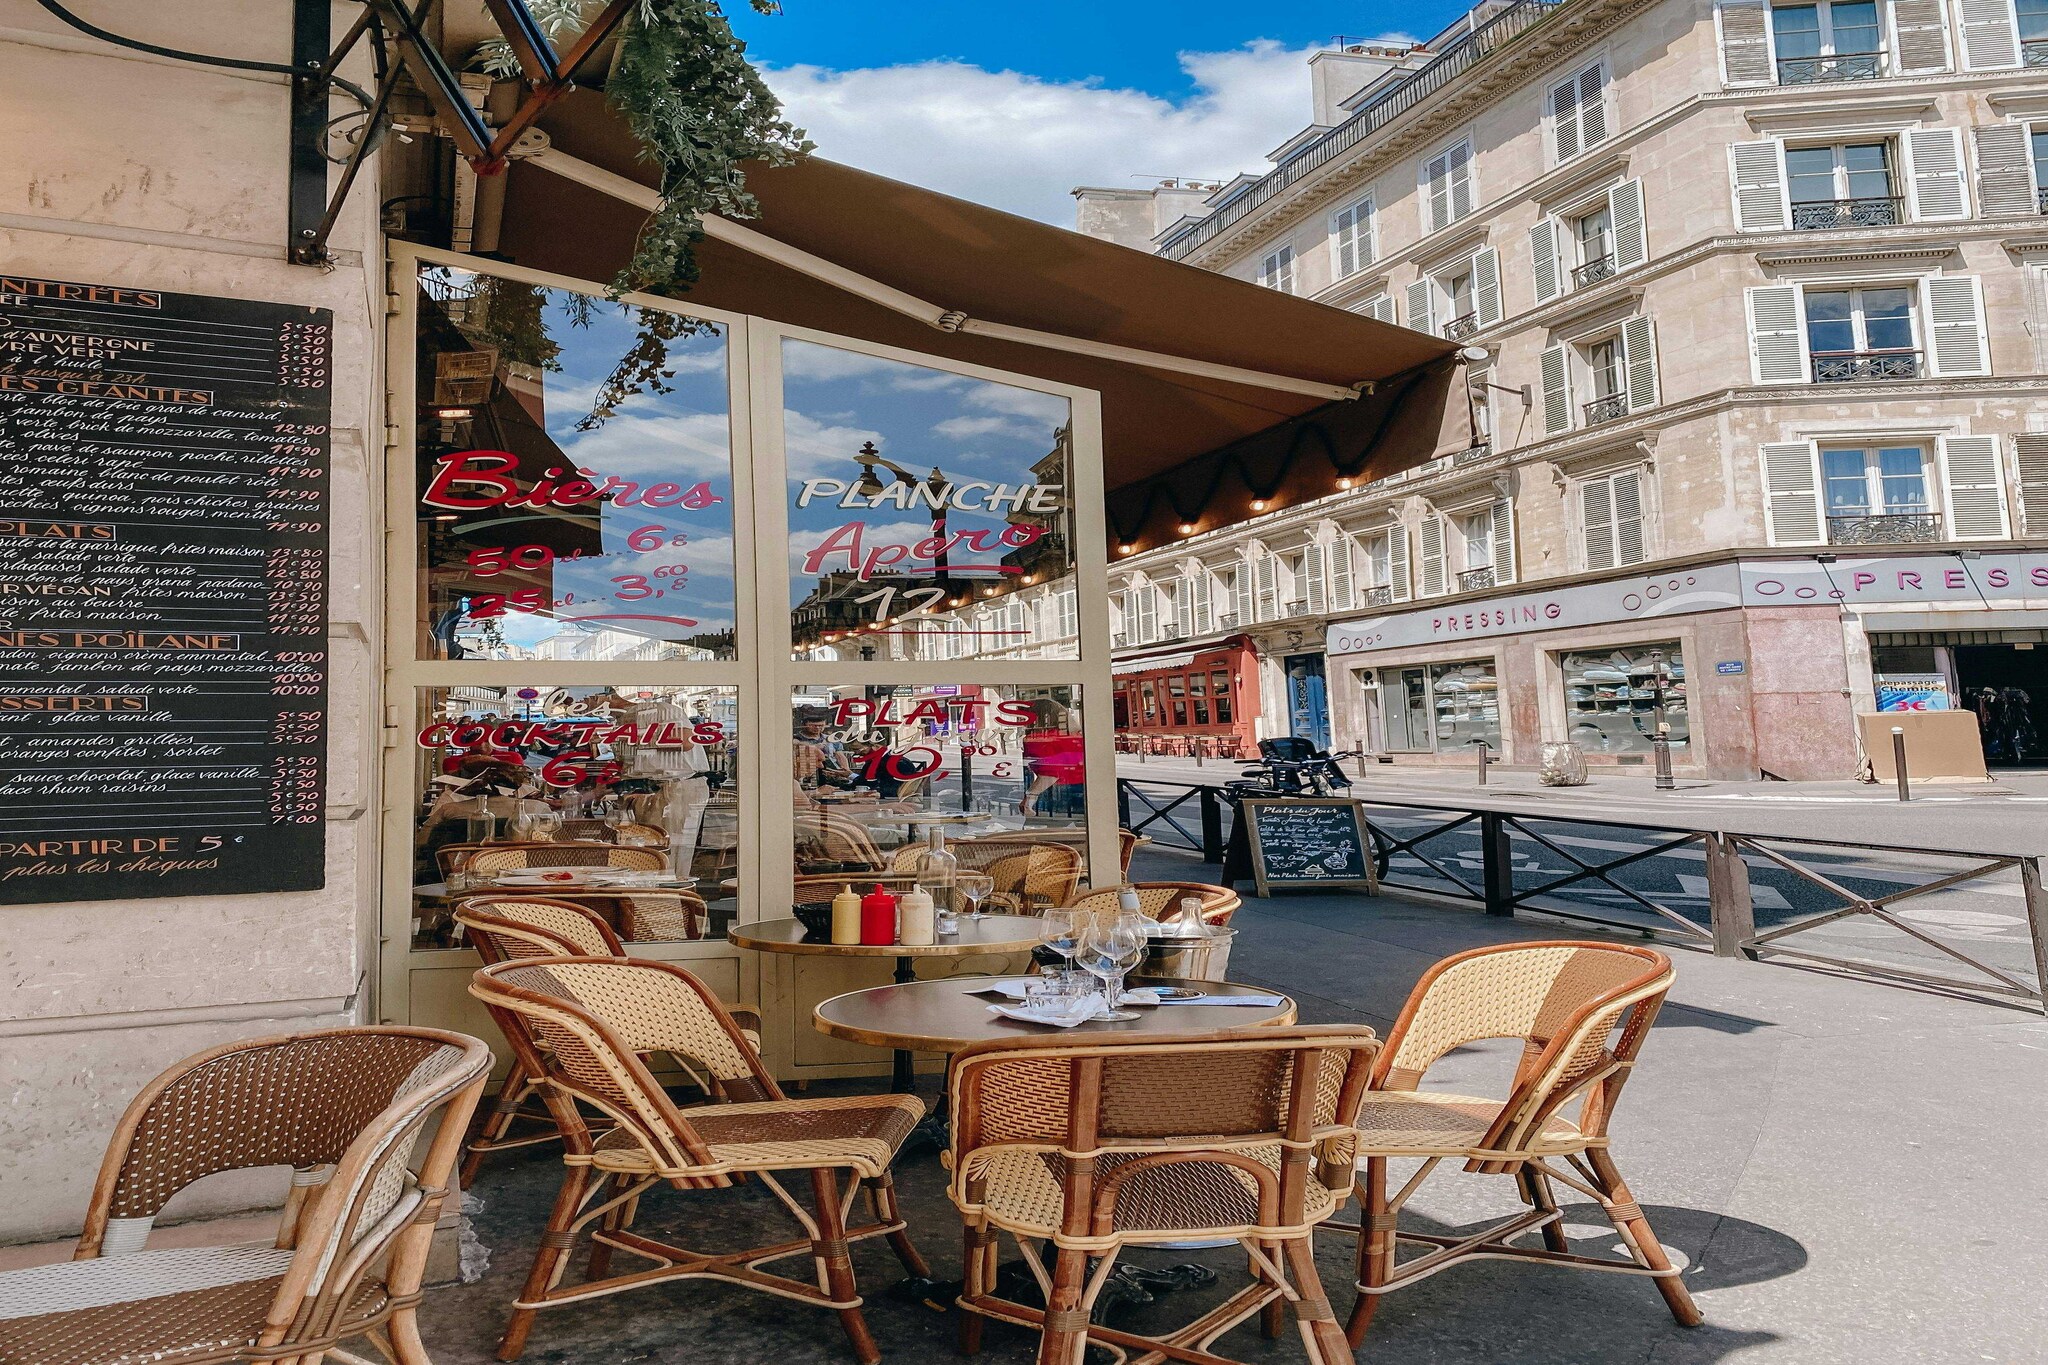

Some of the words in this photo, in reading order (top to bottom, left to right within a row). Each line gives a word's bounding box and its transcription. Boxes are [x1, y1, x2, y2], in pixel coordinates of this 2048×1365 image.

[54, 345, 121, 360] VERT
[57, 381, 209, 405] GÉANTES
[8, 403, 88, 418] jambon
[90, 410, 114, 421] de
[117, 412, 167, 425] pays
[81, 398, 105, 409] de
[106, 398, 141, 411] foie
[146, 403, 184, 418] gras
[186, 404, 208, 416] de
[67, 419, 110, 432] brick
[114, 423, 134, 433] de
[20, 428, 79, 441] olives
[78, 444, 99, 453] de
[101, 447, 173, 459] saumon
[98, 468, 149, 481] blanc
[150, 472, 172, 482] de
[174, 472, 241, 485] poulet
[422, 450, 723, 512] Bières
[88, 479, 135, 490] durs
[141, 493, 180, 505] pois
[796, 478, 1063, 514] PLANCHE
[70, 501, 145, 515] oignons
[31, 549, 92, 561] salade
[97, 552, 136, 562] verte
[36, 540, 58, 549] de
[59, 540, 77, 550] la
[161, 543, 206, 556] frites
[207, 546, 265, 557] maison
[801, 519, 1051, 583] Apéro
[467, 545, 555, 577] 50
[90, 562, 149, 574] salade
[156, 567, 197, 577] verte
[61, 574, 84, 583] de
[1853, 565, 2048, 592] PRESS
[24, 583, 112, 597] VÉGAN
[121, 586, 172, 599] frites
[176, 589, 247, 600] maison
[49, 599, 77, 607] au
[81, 597, 144, 609] beurre
[29, 607, 82, 621] frites
[84, 609, 162, 621] maison
[1432, 602, 1562, 634] PRESSING
[75, 630, 232, 649] POÎLANE
[173, 650, 268, 662] emmental
[46, 660, 125, 674] jambon
[129, 662, 152, 672] de
[95, 684, 153, 695] salade
[158, 685, 198, 695] verte
[48, 711, 100, 725] glace
[107, 710, 173, 722] vanille
[827, 698, 1038, 728] PLATS
[26, 734, 115, 746] amandes
[417, 721, 725, 749] COCKTAILS
[163, 745, 223, 758] sorbet
[9, 773, 65, 784] sauce
[147, 769, 195, 786] glace
[199, 766, 260, 780] vanille
[37, 782, 93, 795] rhum
[98, 780, 168, 794] raisins
[1263, 806, 1293, 814] Plats
[133, 837, 180, 853] DE
[2, 861, 68, 882] plus
[73, 858, 111, 874] les
[116, 856, 219, 877] chèques
